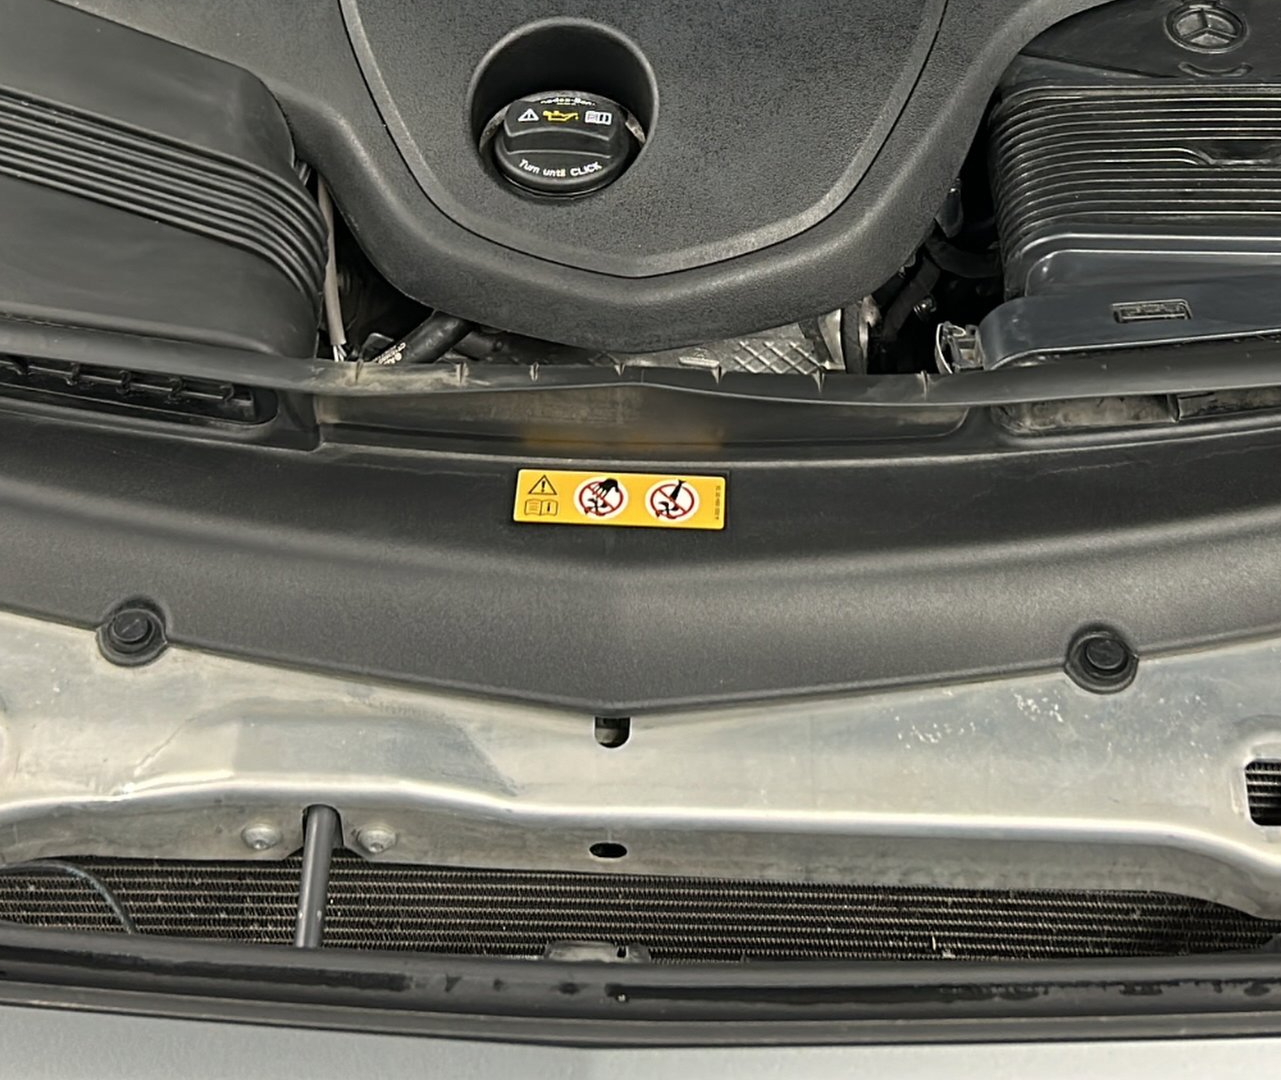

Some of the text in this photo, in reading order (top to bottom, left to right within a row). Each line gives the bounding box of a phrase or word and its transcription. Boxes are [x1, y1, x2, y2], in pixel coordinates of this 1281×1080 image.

[519, 158, 602, 177] Turn until CLICK
